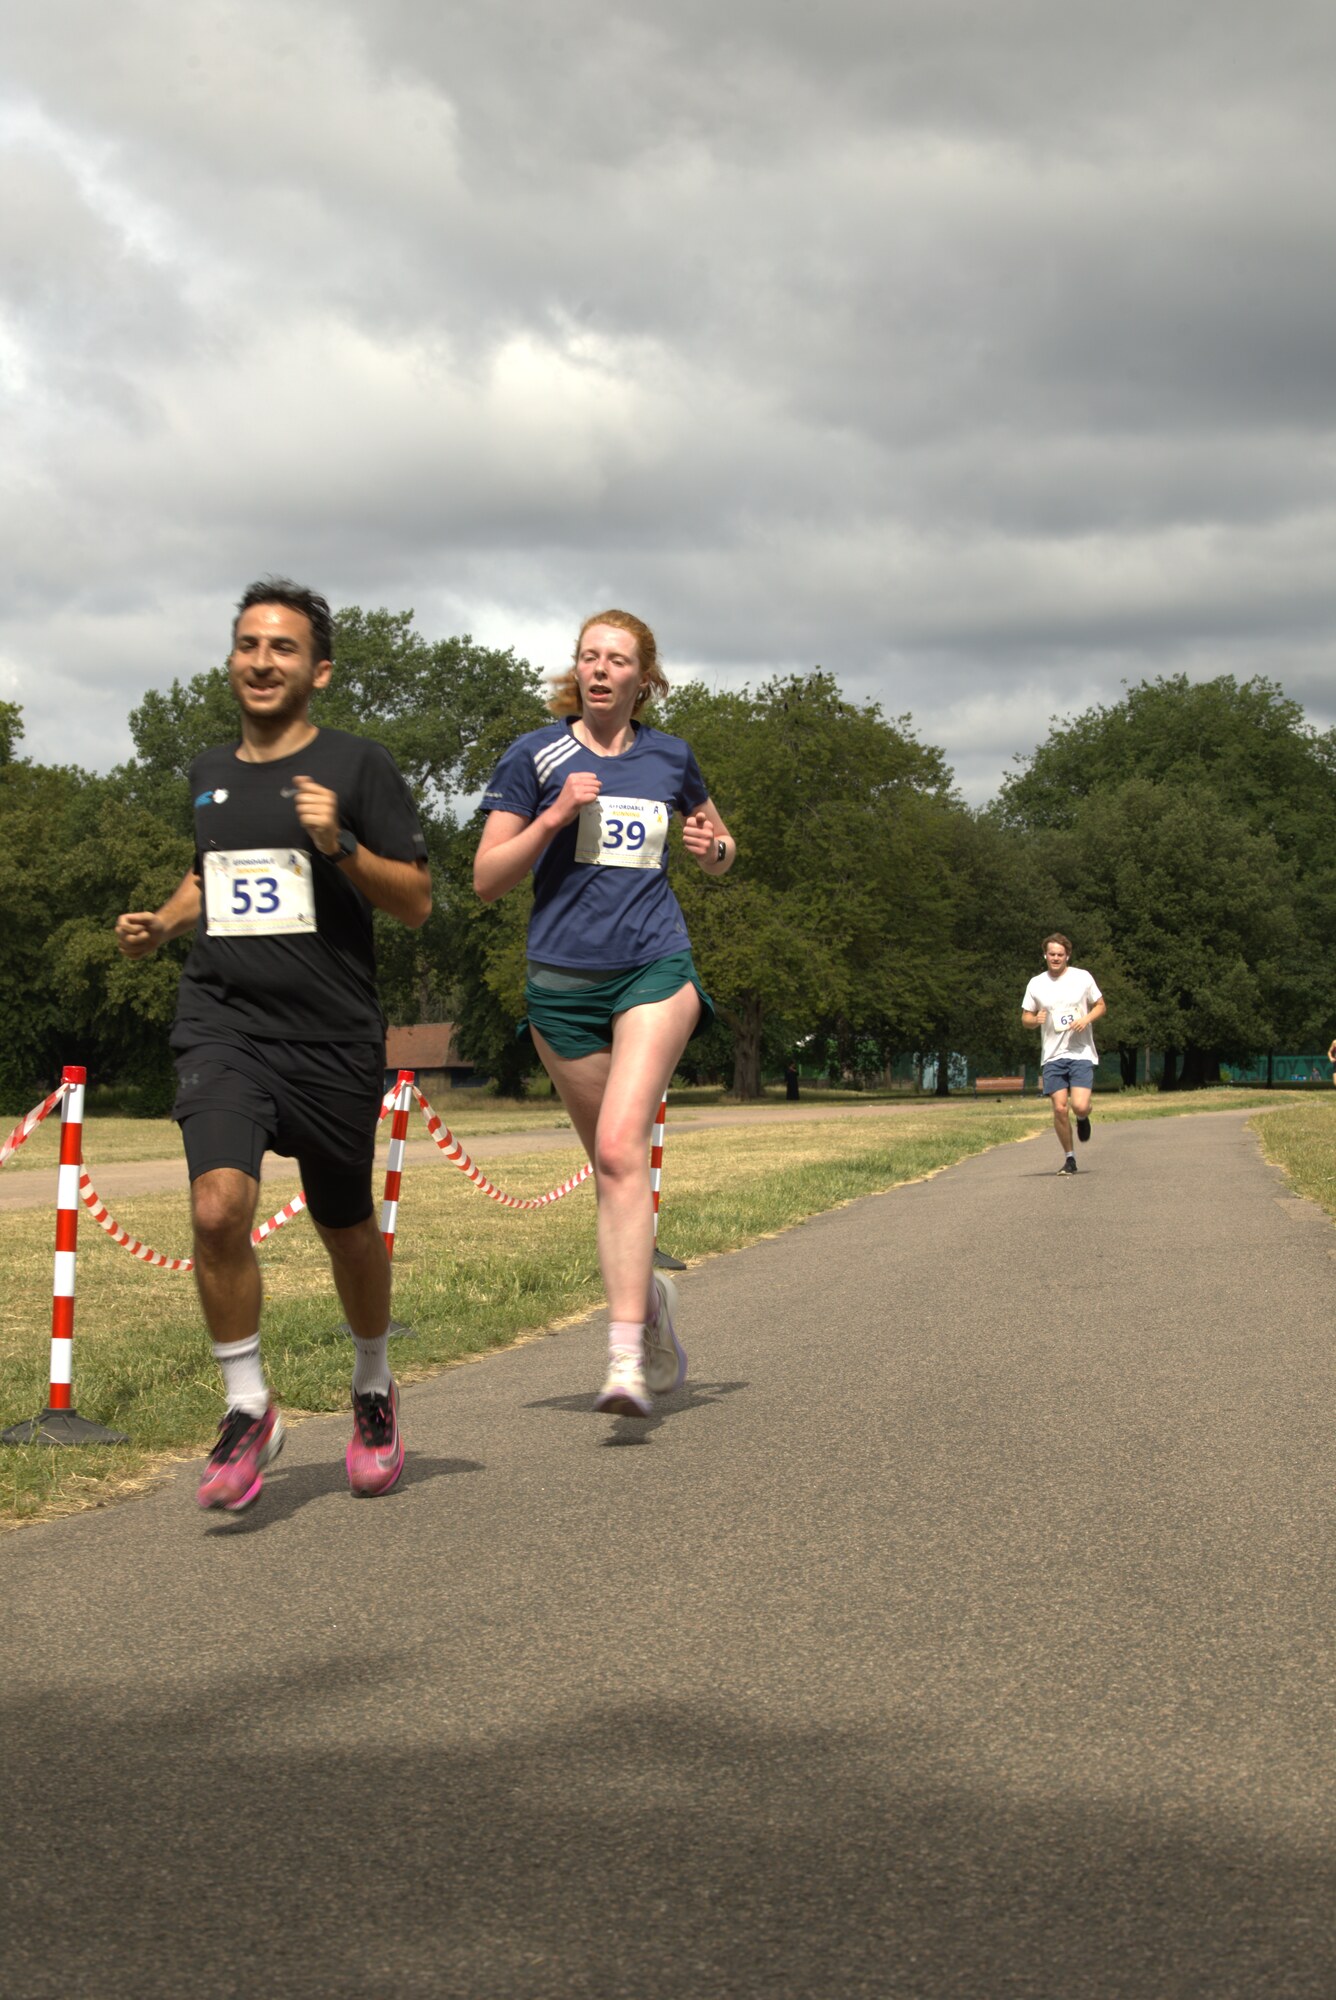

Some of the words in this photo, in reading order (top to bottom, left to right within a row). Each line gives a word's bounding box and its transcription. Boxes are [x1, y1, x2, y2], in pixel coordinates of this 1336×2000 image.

[602, 819, 646, 851] 39
[231, 877, 281, 915] 53
[1060, 1014, 1075, 1026] 63
